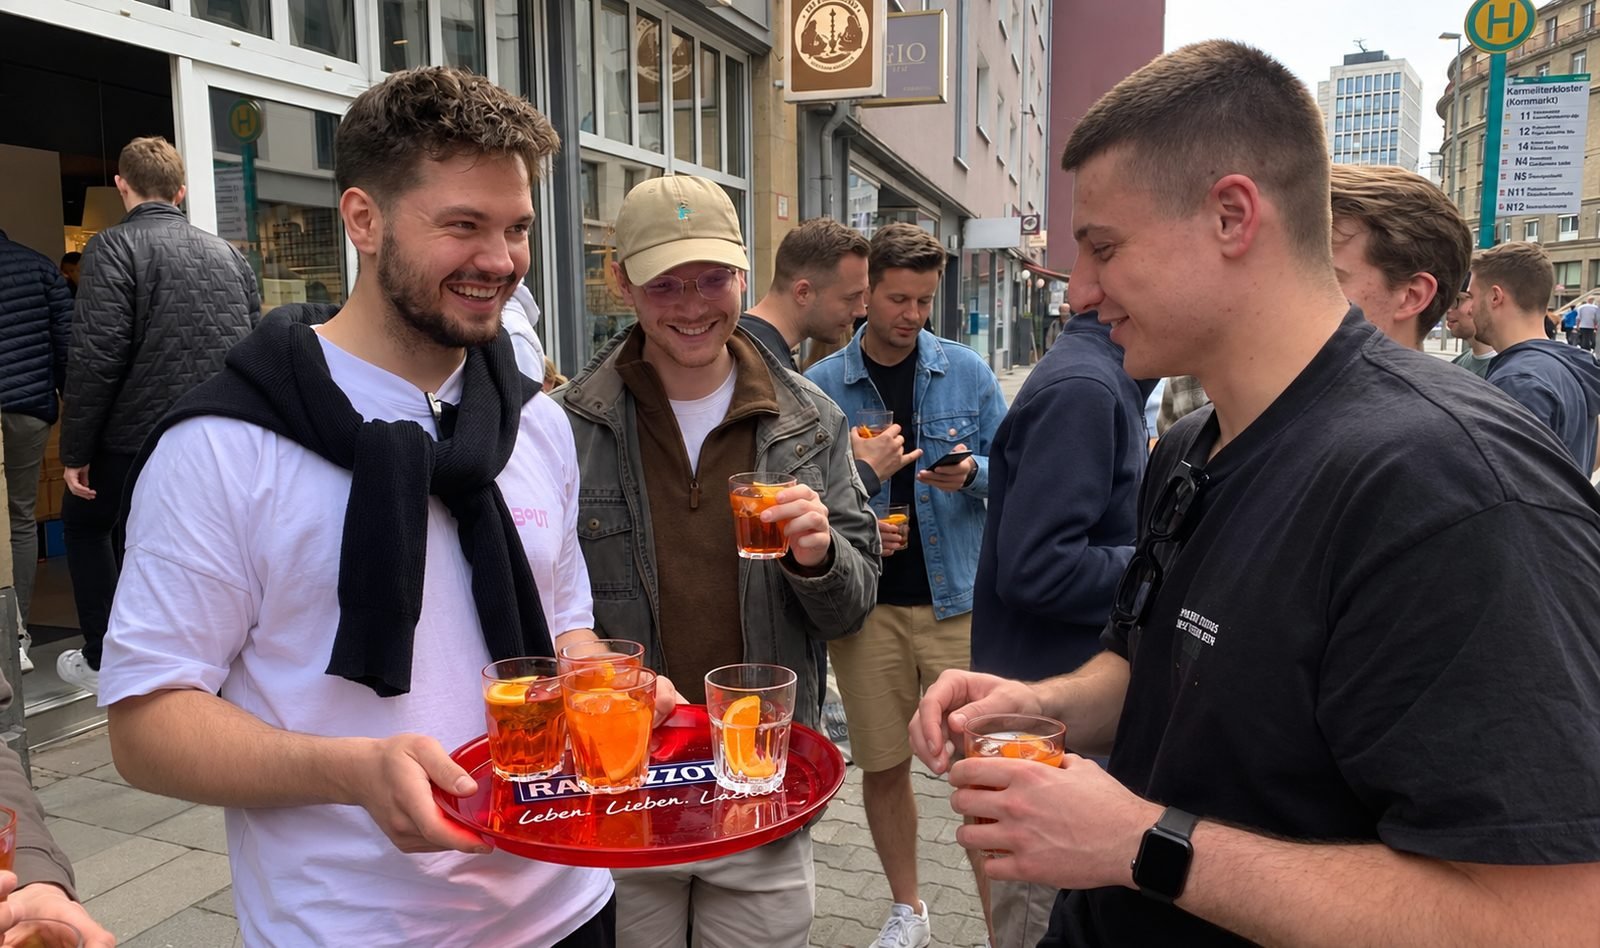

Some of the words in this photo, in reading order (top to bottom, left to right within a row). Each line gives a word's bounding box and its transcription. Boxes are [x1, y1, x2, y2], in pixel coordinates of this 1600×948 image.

[1487, 2, 1515, 39] H
[1506, 84, 1584, 96] Karmeliterkloster
[1506, 96, 1558, 108] (Kornmarkt)
[1520, 111, 1531, 121] 11
[1519, 127, 1531, 136] 12
[1518, 142, 1529, 151] 14
[1515, 157, 1528, 166] N4
[1507, 188, 1525, 198] N11
[1506, 203, 1525, 212] N12
[528, 764, 718, 797] RAZZOT
[518, 808, 592, 825] Leben.
[605, 796, 689, 815] Lieben.
